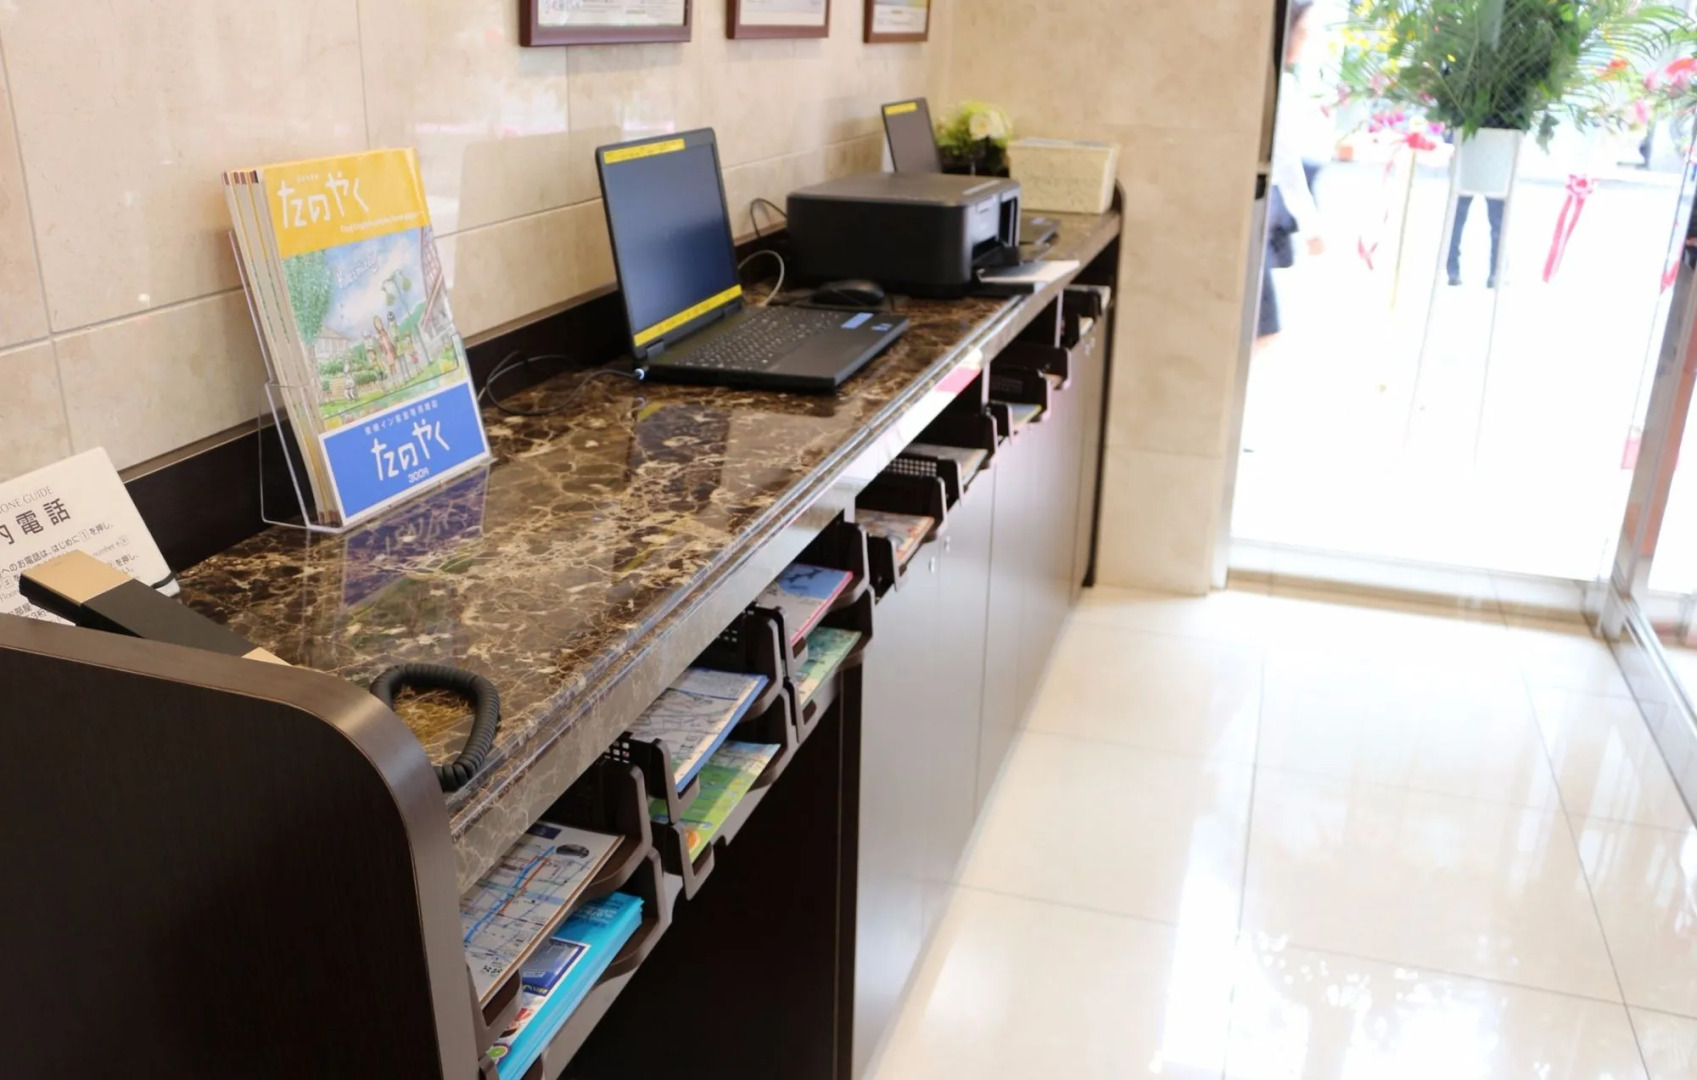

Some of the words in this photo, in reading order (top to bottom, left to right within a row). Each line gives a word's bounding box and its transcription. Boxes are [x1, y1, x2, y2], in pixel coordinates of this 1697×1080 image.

[277, 171, 370, 229] たのやく
[371, 418, 450, 481] たのやく
[0, 498, 23, 515] ONE
[23, 485, 54, 504] GUIDE
